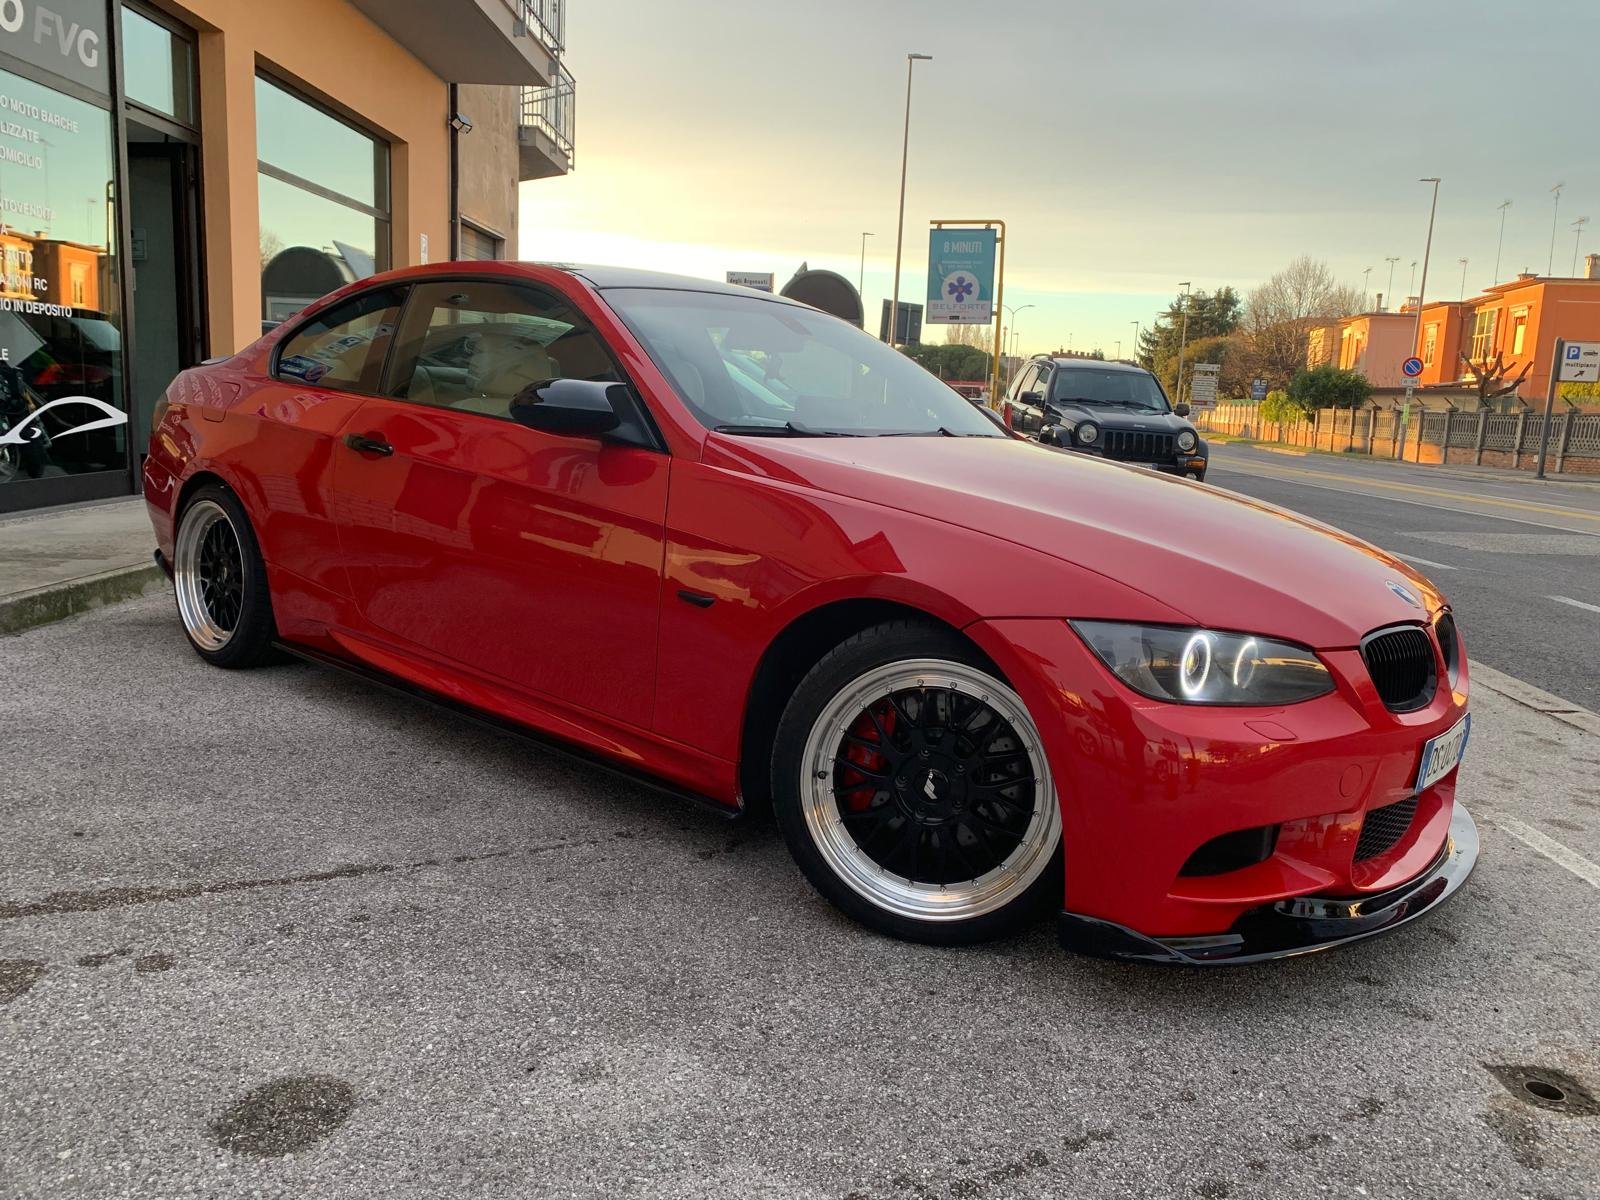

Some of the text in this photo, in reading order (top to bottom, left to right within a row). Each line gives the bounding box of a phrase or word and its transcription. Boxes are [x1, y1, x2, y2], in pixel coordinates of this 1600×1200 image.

[33, 5, 99, 68] FVG
[10, 97, 39, 119] MOTO
[41, 109, 80, 133] BARCHE
[943, 241, 983, 253] 8 MINUTI
[34, 277, 48, 291] RC
[13, 299, 24, 313] IN
[26, 301, 73, 318] DEPOSITO
